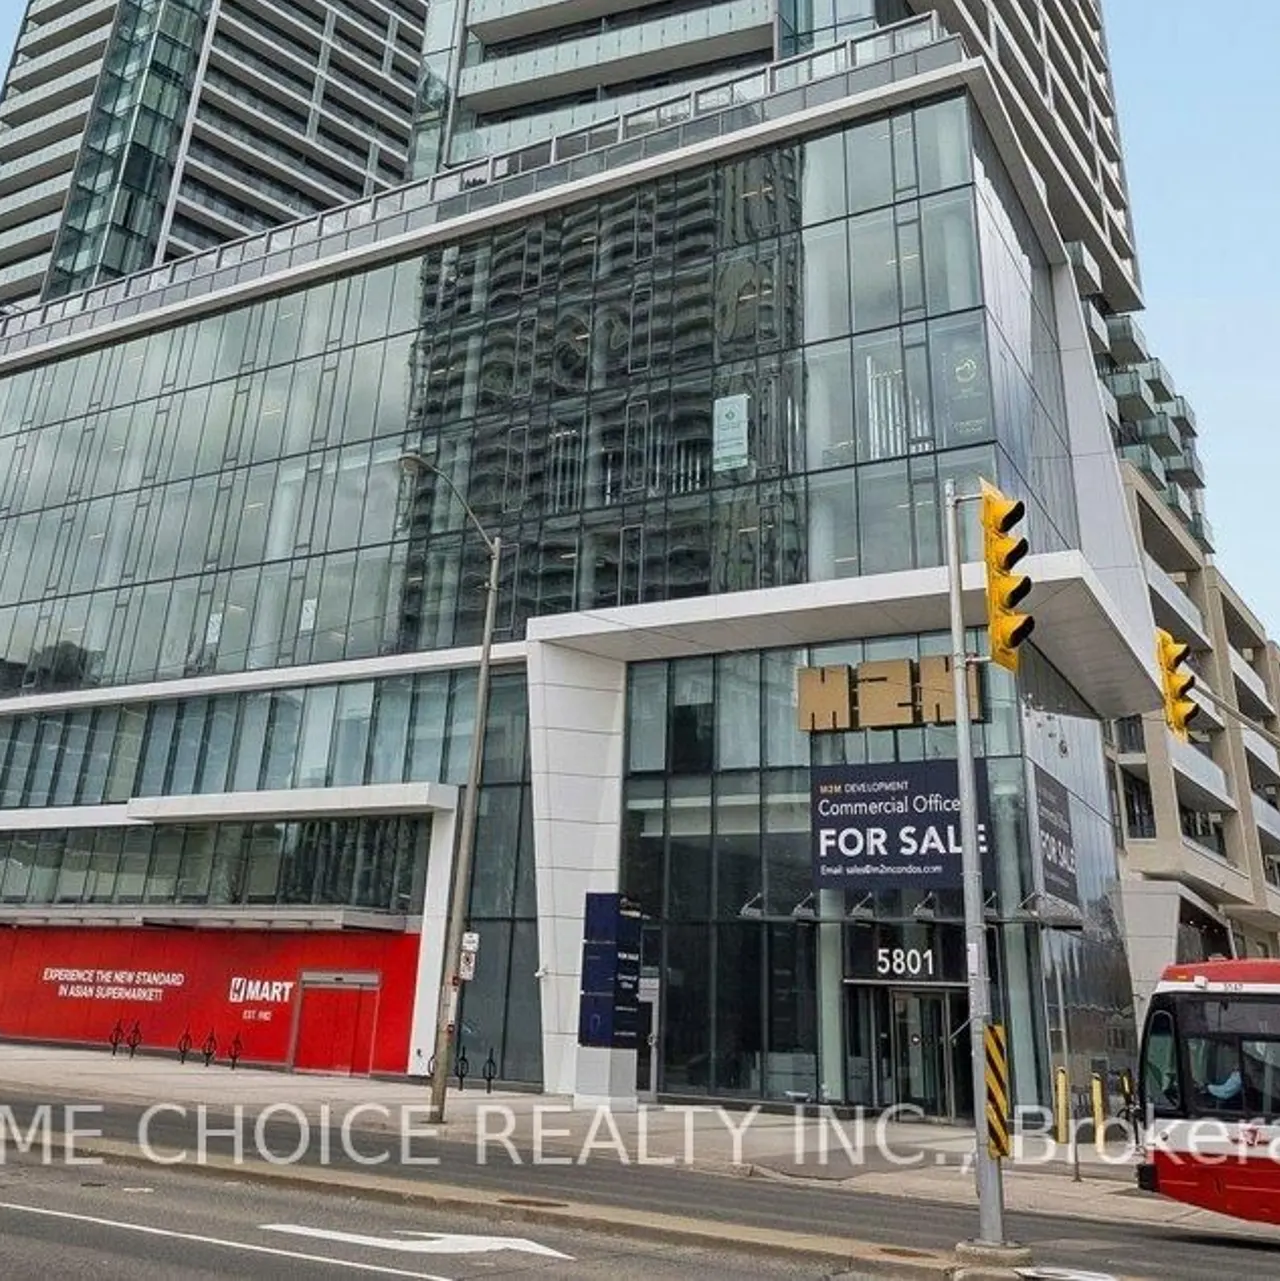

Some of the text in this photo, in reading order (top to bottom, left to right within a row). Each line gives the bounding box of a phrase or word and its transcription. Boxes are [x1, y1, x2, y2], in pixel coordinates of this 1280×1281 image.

[844, 780, 908, 793] DEVELOPMENT
[818, 796, 909, 817] Commercial
[819, 827, 888, 857] FOR
[877, 948, 934, 975] 5801
[42, 967, 185, 987] EXPERIENCE THE NEW STANDARD
[58, 983, 68, 997] IN
[69, 984, 94, 998] ASIAN
[246, 979, 295, 1002] MART
